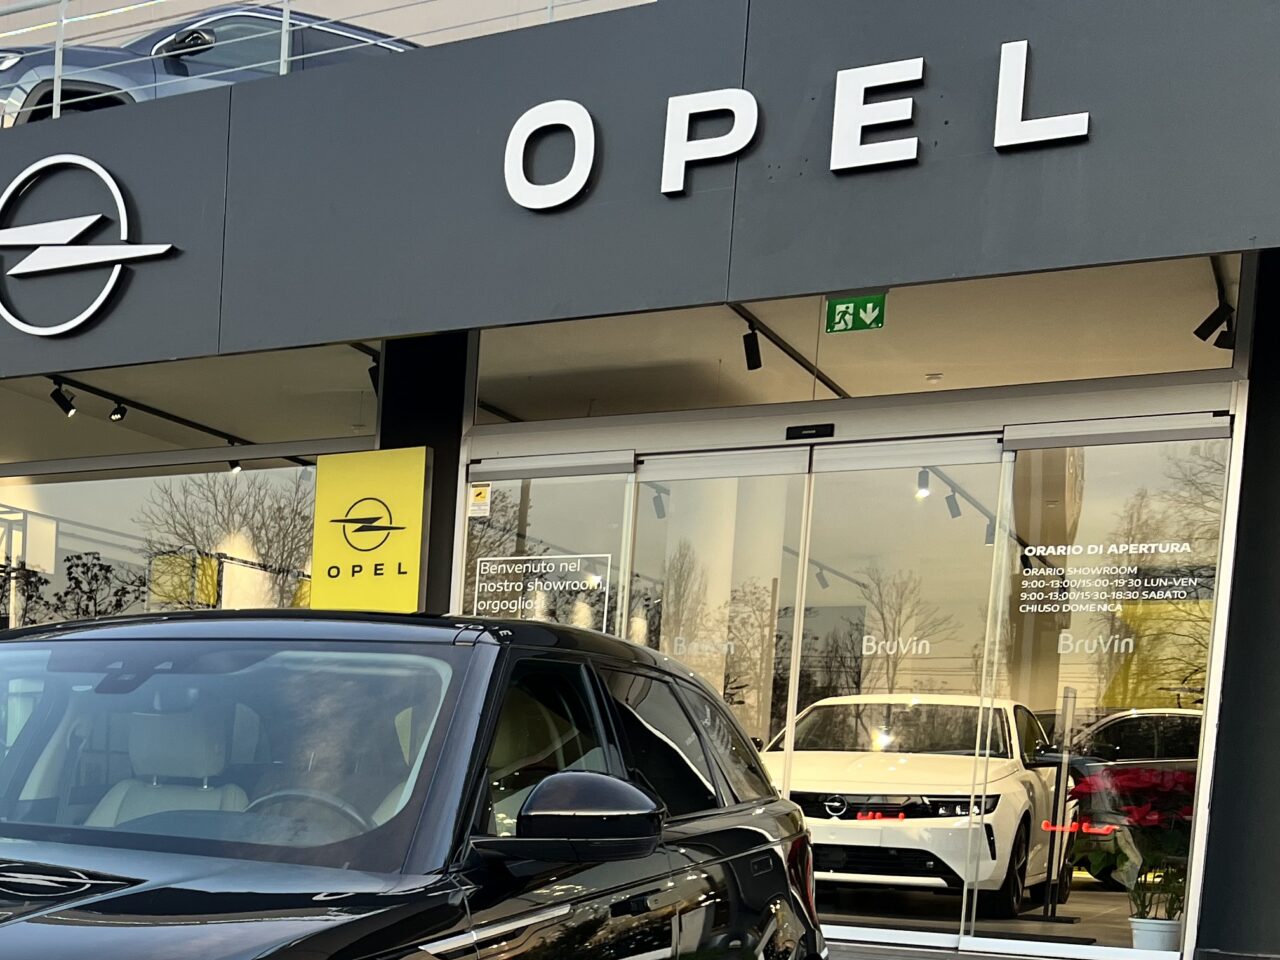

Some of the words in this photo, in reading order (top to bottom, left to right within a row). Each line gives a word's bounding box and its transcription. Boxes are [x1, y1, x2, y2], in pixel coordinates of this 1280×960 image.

[503, 40, 1090, 210] OPEL
[1024, 545, 1083, 556] ORARIO
[1087, 544, 1104, 555] DI
[1107, 543, 1191, 554] APERTURA
[327, 562, 408, 579] OPEL
[480, 561, 555, 575] Benvenuto
[559, 558, 581, 572] nel
[1023, 567, 1065, 577] ORARIO
[1066, 566, 1138, 576] SHOWROOM
[479, 579, 524, 592] nostro
[1144, 577, 1198, 587] LUN-VEN
[1142, 590, 1187, 599] SABATO
[1019, 603, 1060, 613] CHIUSO
[1062, 603, 1123, 612] DOMENICA
[862, 635, 930, 655] BruVin
[1057, 633, 1134, 654] BruVin
